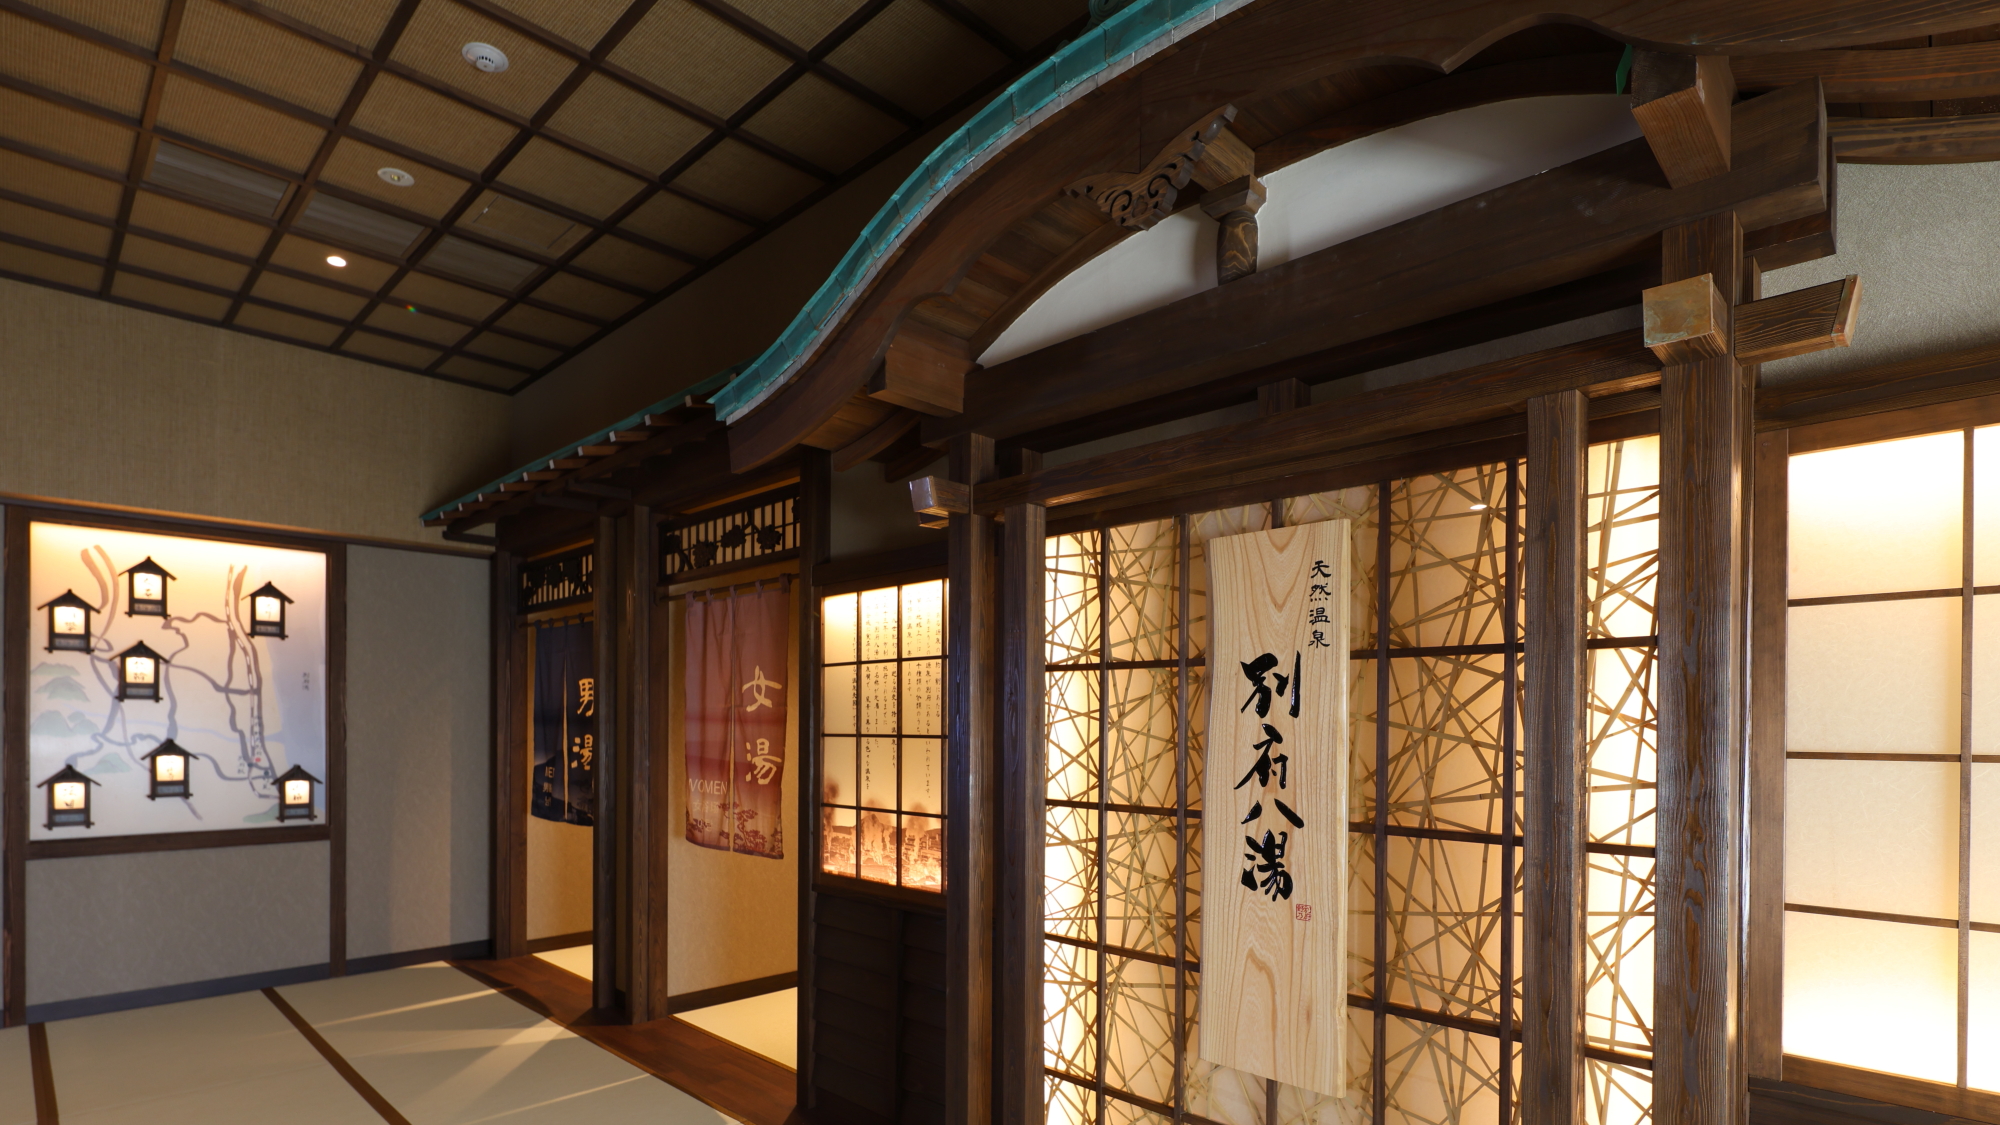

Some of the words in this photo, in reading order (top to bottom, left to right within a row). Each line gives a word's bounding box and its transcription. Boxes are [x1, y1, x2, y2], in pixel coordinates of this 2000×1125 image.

[1308, 560, 1332, 649] 天然温泉
[571, 677, 594, 771] 男湯
[742, 665, 783, 785] 女湯
[1233, 650, 1305, 902] 別府八湯
